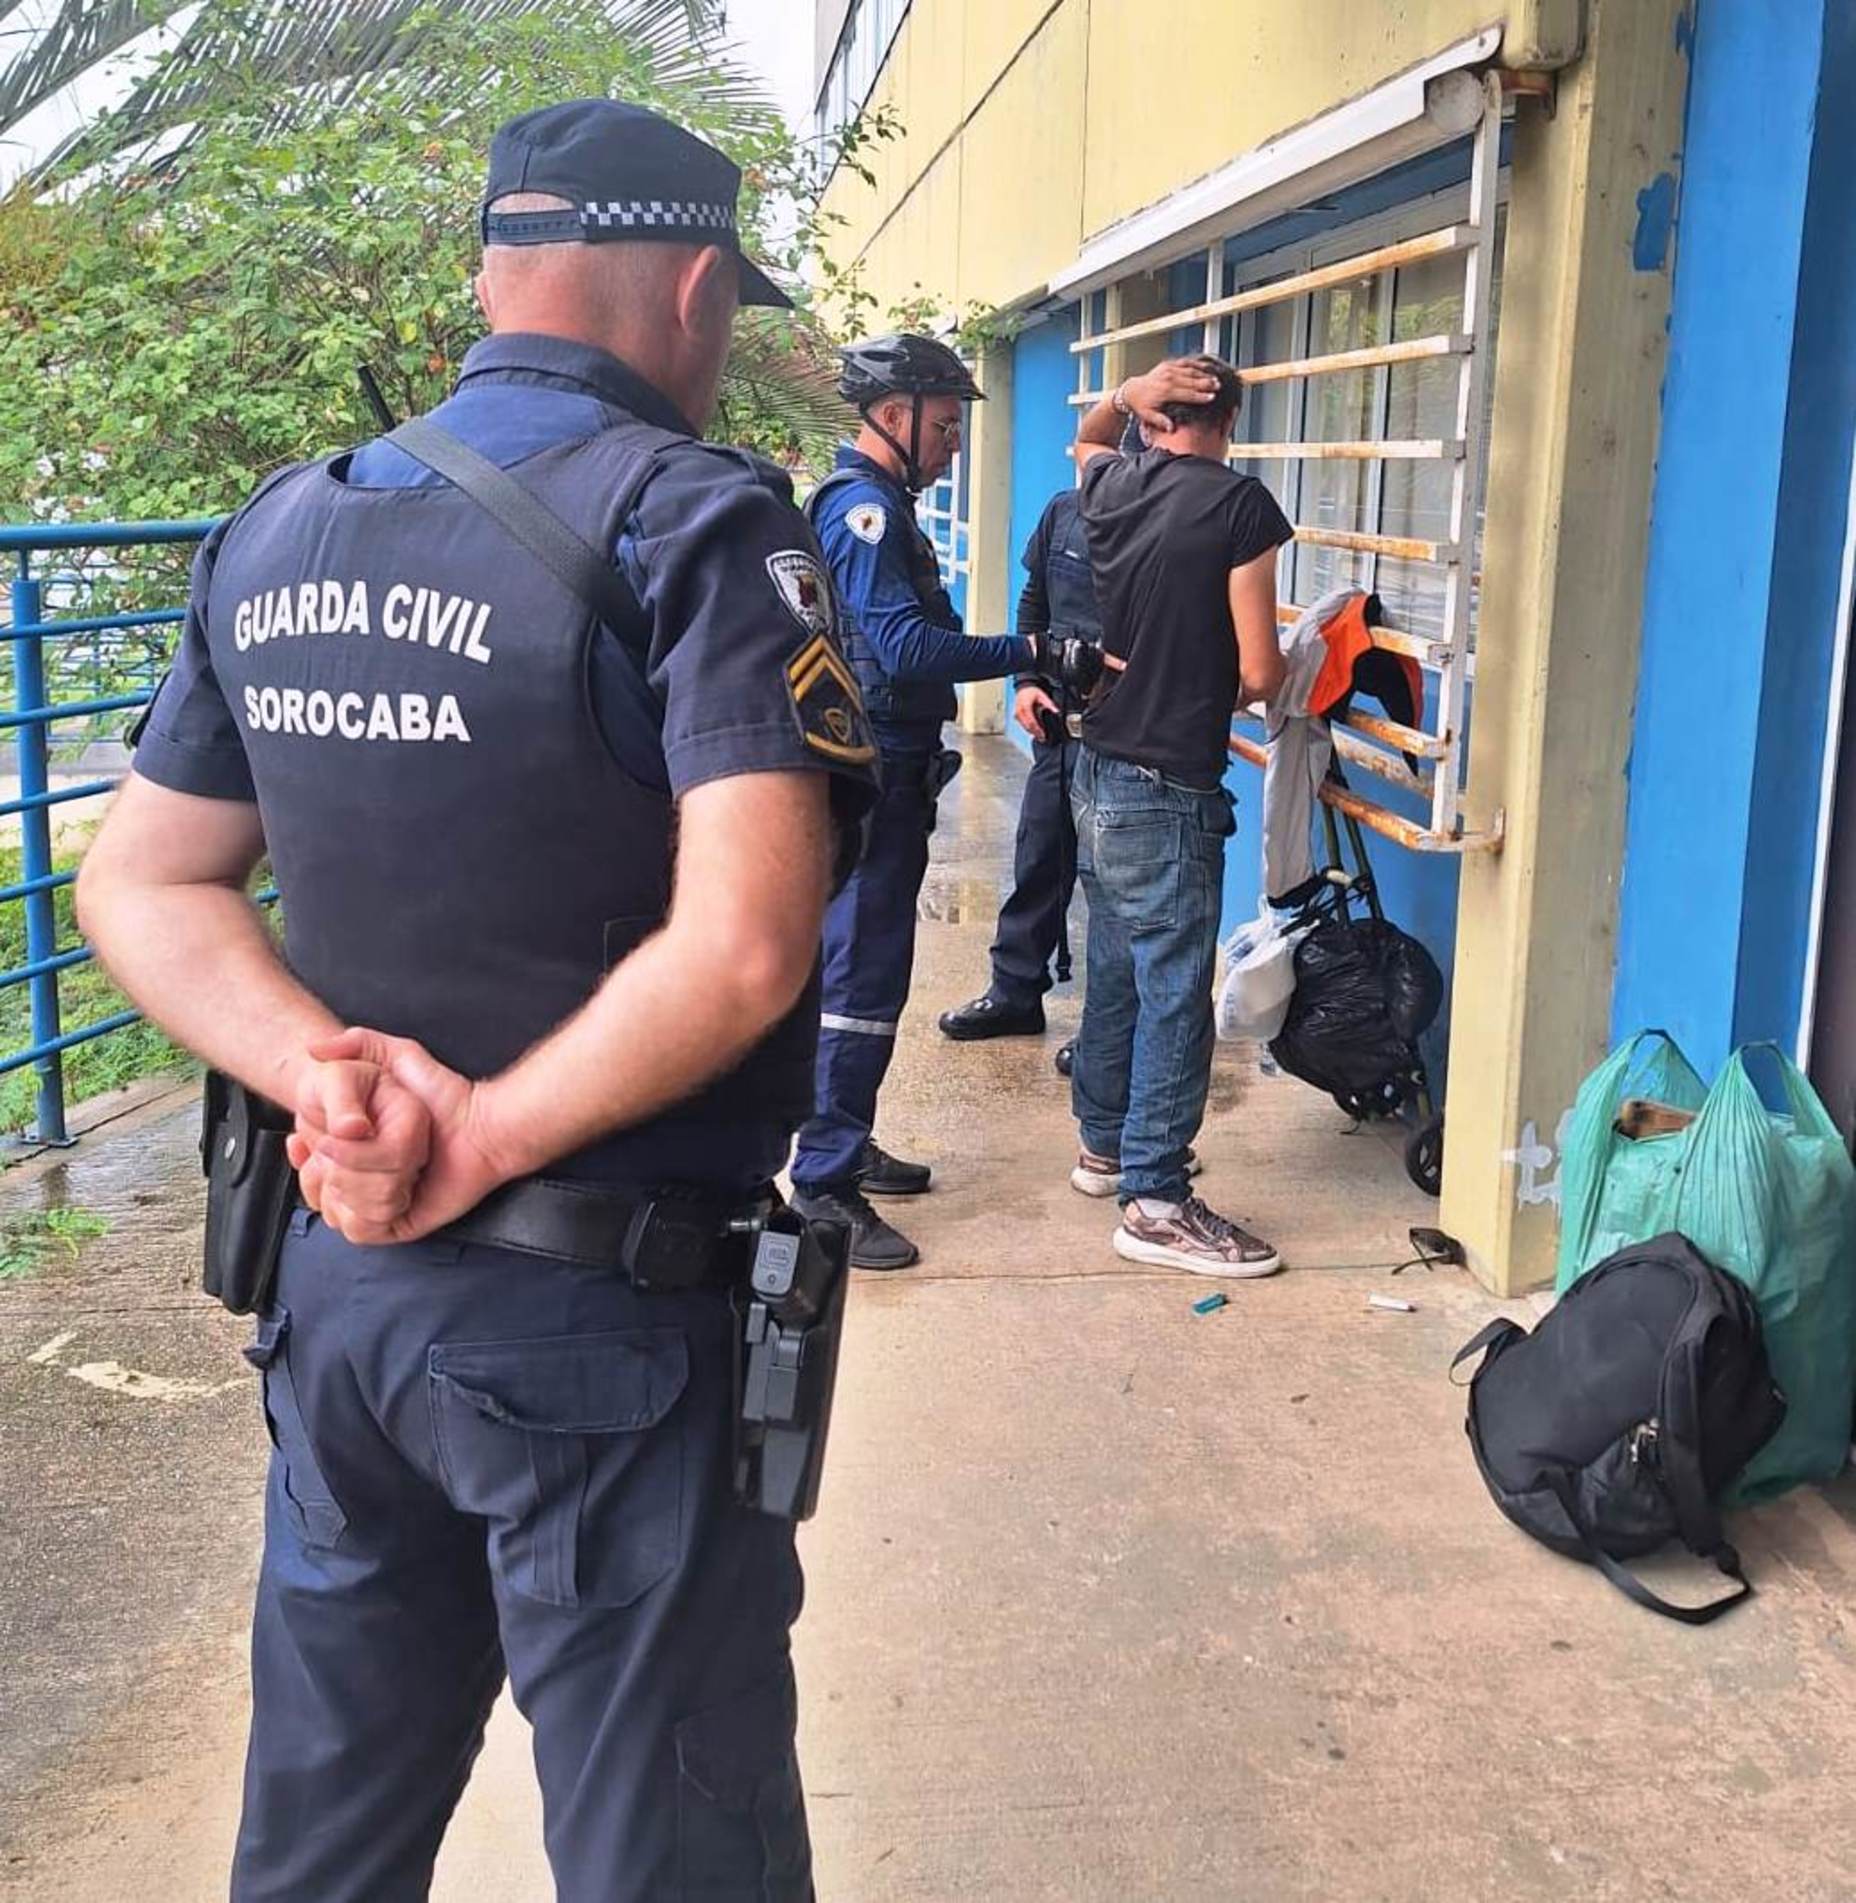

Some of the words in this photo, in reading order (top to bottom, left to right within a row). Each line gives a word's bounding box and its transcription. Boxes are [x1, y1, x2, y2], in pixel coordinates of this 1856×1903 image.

[234, 581, 370, 652] GUARDA
[382, 583, 492, 664] CIVIL
[244, 685, 472, 742] SOROCABA
